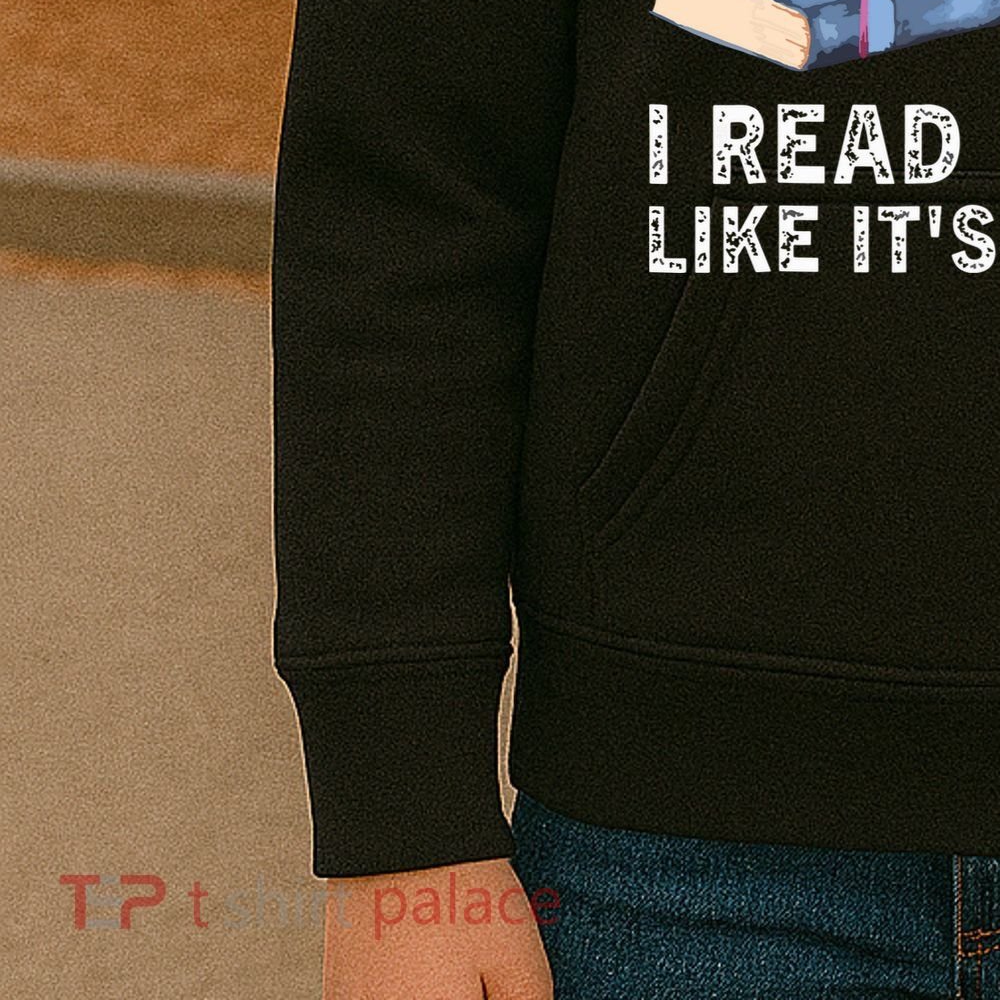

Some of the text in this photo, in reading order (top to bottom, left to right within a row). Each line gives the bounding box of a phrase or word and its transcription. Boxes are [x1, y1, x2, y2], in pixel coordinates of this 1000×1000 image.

[648, 103, 667, 184] I
[712, 103, 960, 184] READ
[648, 205, 818, 273] LIKE
[853, 204, 995, 273] IT'S
